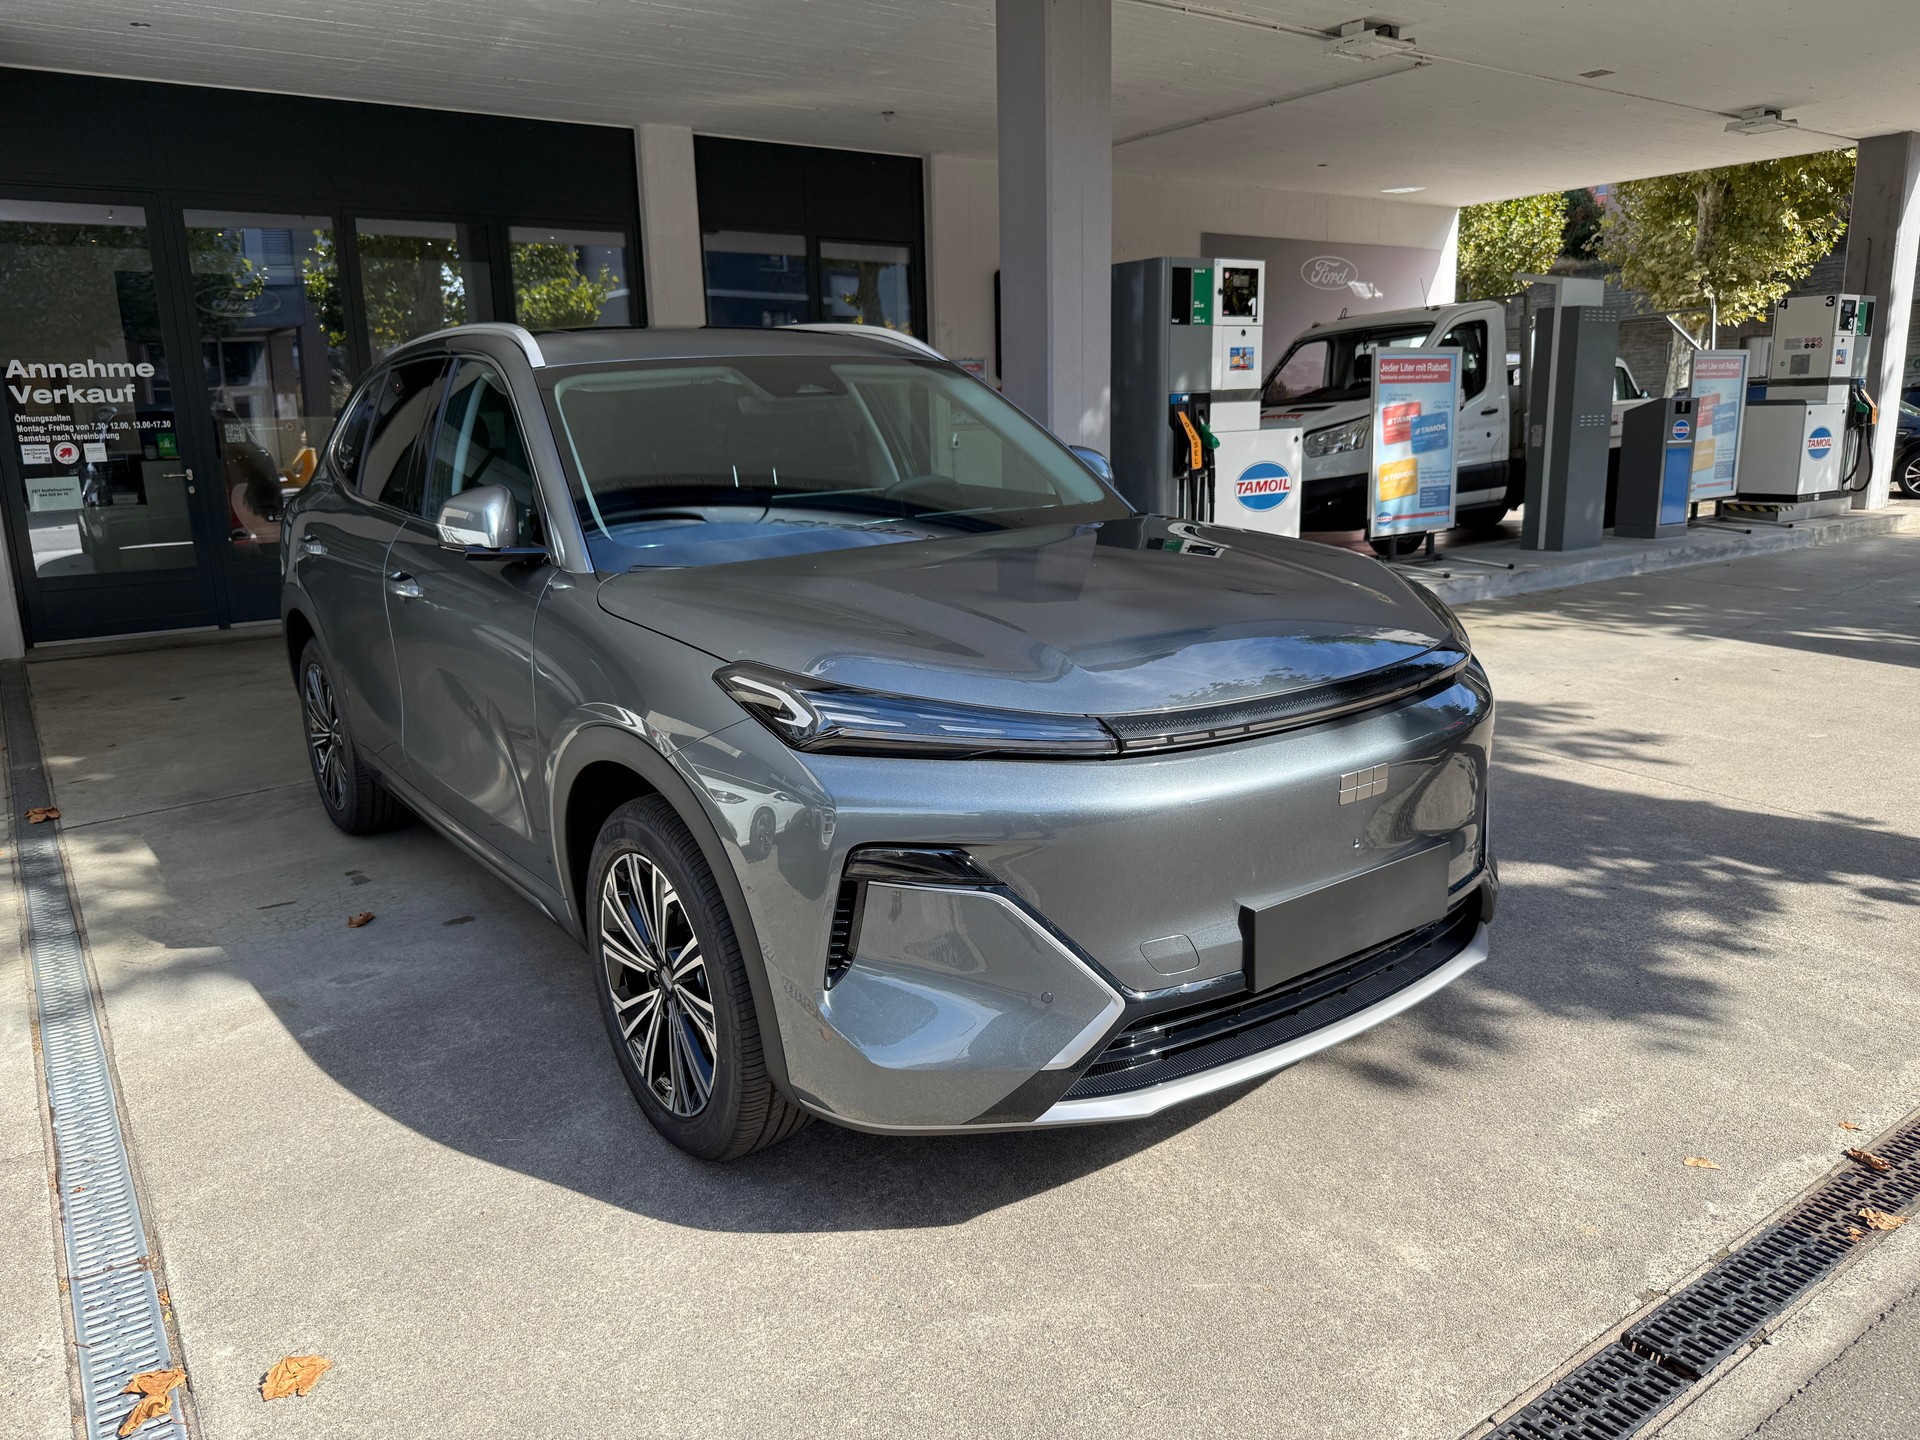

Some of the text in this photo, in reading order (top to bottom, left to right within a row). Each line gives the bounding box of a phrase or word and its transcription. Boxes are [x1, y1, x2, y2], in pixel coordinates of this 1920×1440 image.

[1311, 260, 1349, 285] Ford
[1247, 297, 1257, 316] 1
[1779, 298, 1788, 309] 4
[1825, 295, 1835, 307] 3
[1847, 317, 1853, 330] 3
[5, 359, 156, 379] Annahme
[1380, 363, 1399, 373] Jeder
[1400, 363, 1416, 372] Liter
[1416, 363, 1426, 372] mit
[8, 384, 136, 404] Verkauf
[14, 413, 71, 424] Öffnungszeiten
[16, 424, 47, 433] Montag-
[48, 424, 74, 432] Freitag
[1420, 423, 1447, 434] TAMOIL
[18, 432, 120, 443] Samstag nach Vereinbarung
[1184, 422, 1199, 465] DIESEL
[1808, 438, 1832, 448] TAMOIL
[1236, 478, 1291, 495] TAMOIL
